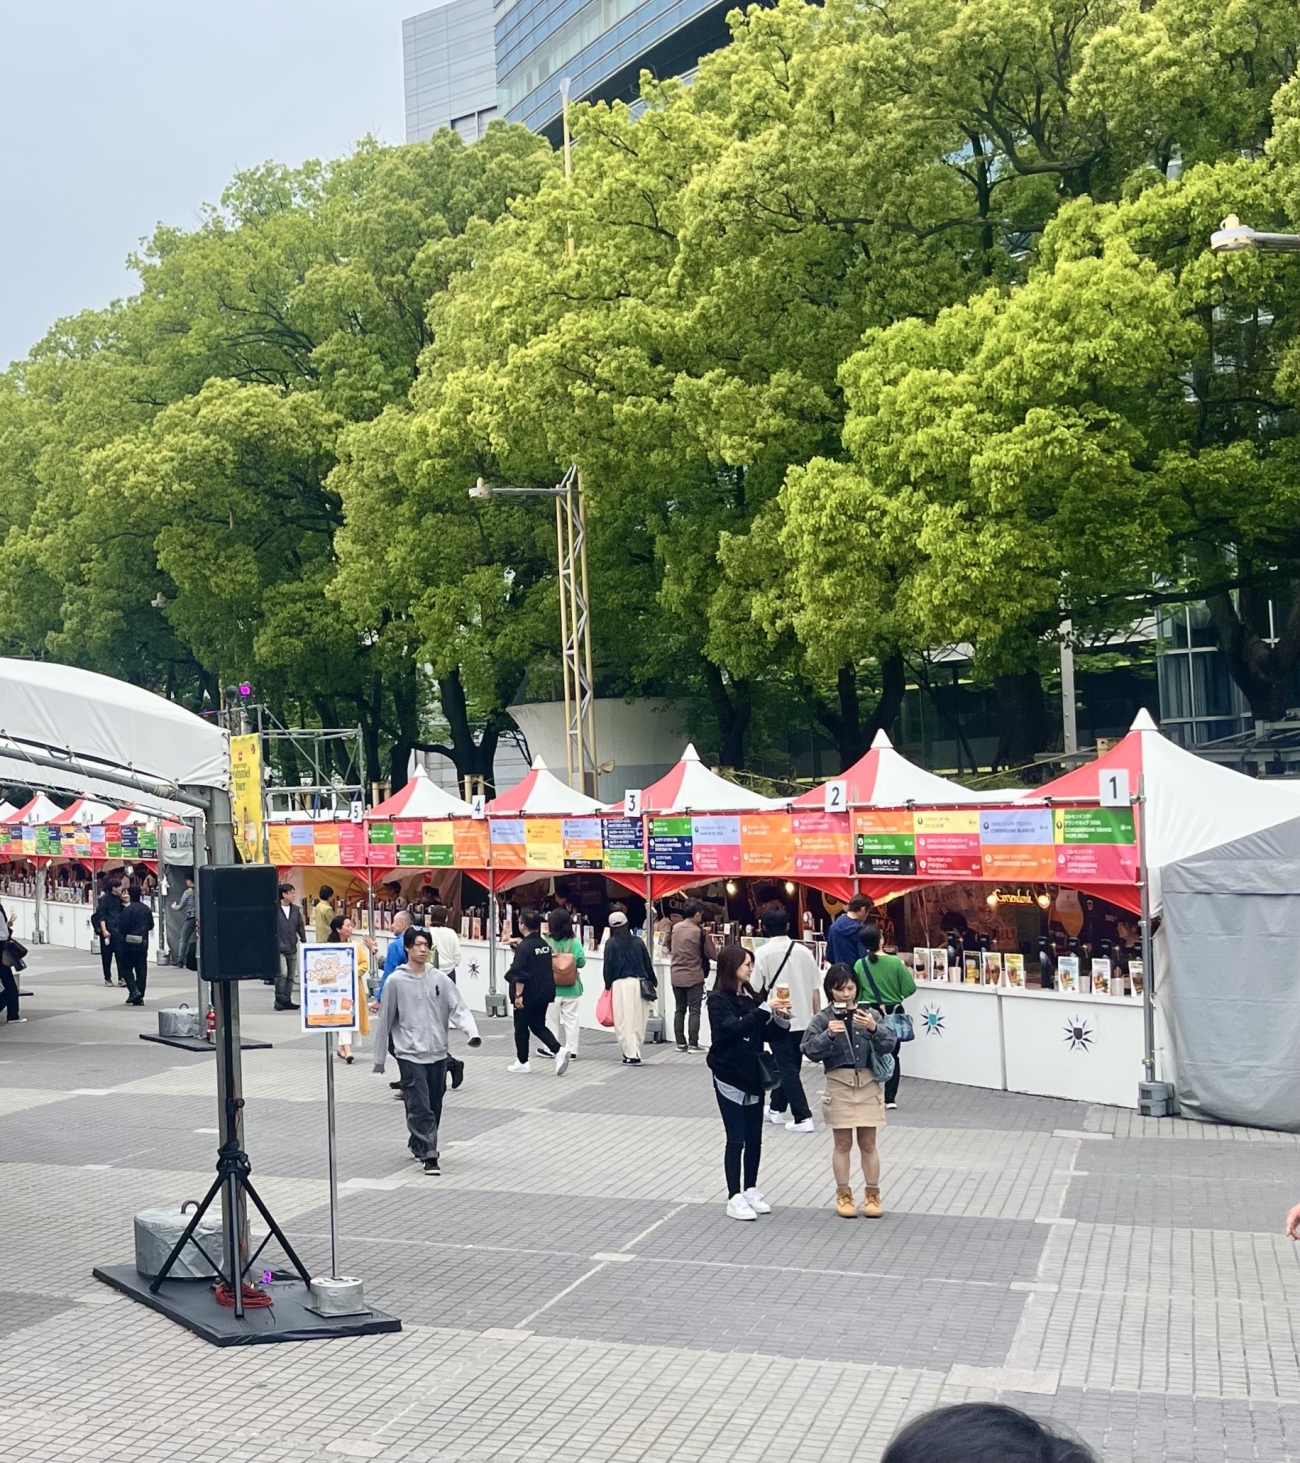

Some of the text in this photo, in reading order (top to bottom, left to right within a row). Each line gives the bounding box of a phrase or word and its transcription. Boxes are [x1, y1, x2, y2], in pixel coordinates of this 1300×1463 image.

[831, 786, 840, 806] 2
[1109, 776, 1117, 799] 1
[474, 799, 481, 814] 4
[628, 794, 636, 811] 3
[353, 805, 359, 819] 5
